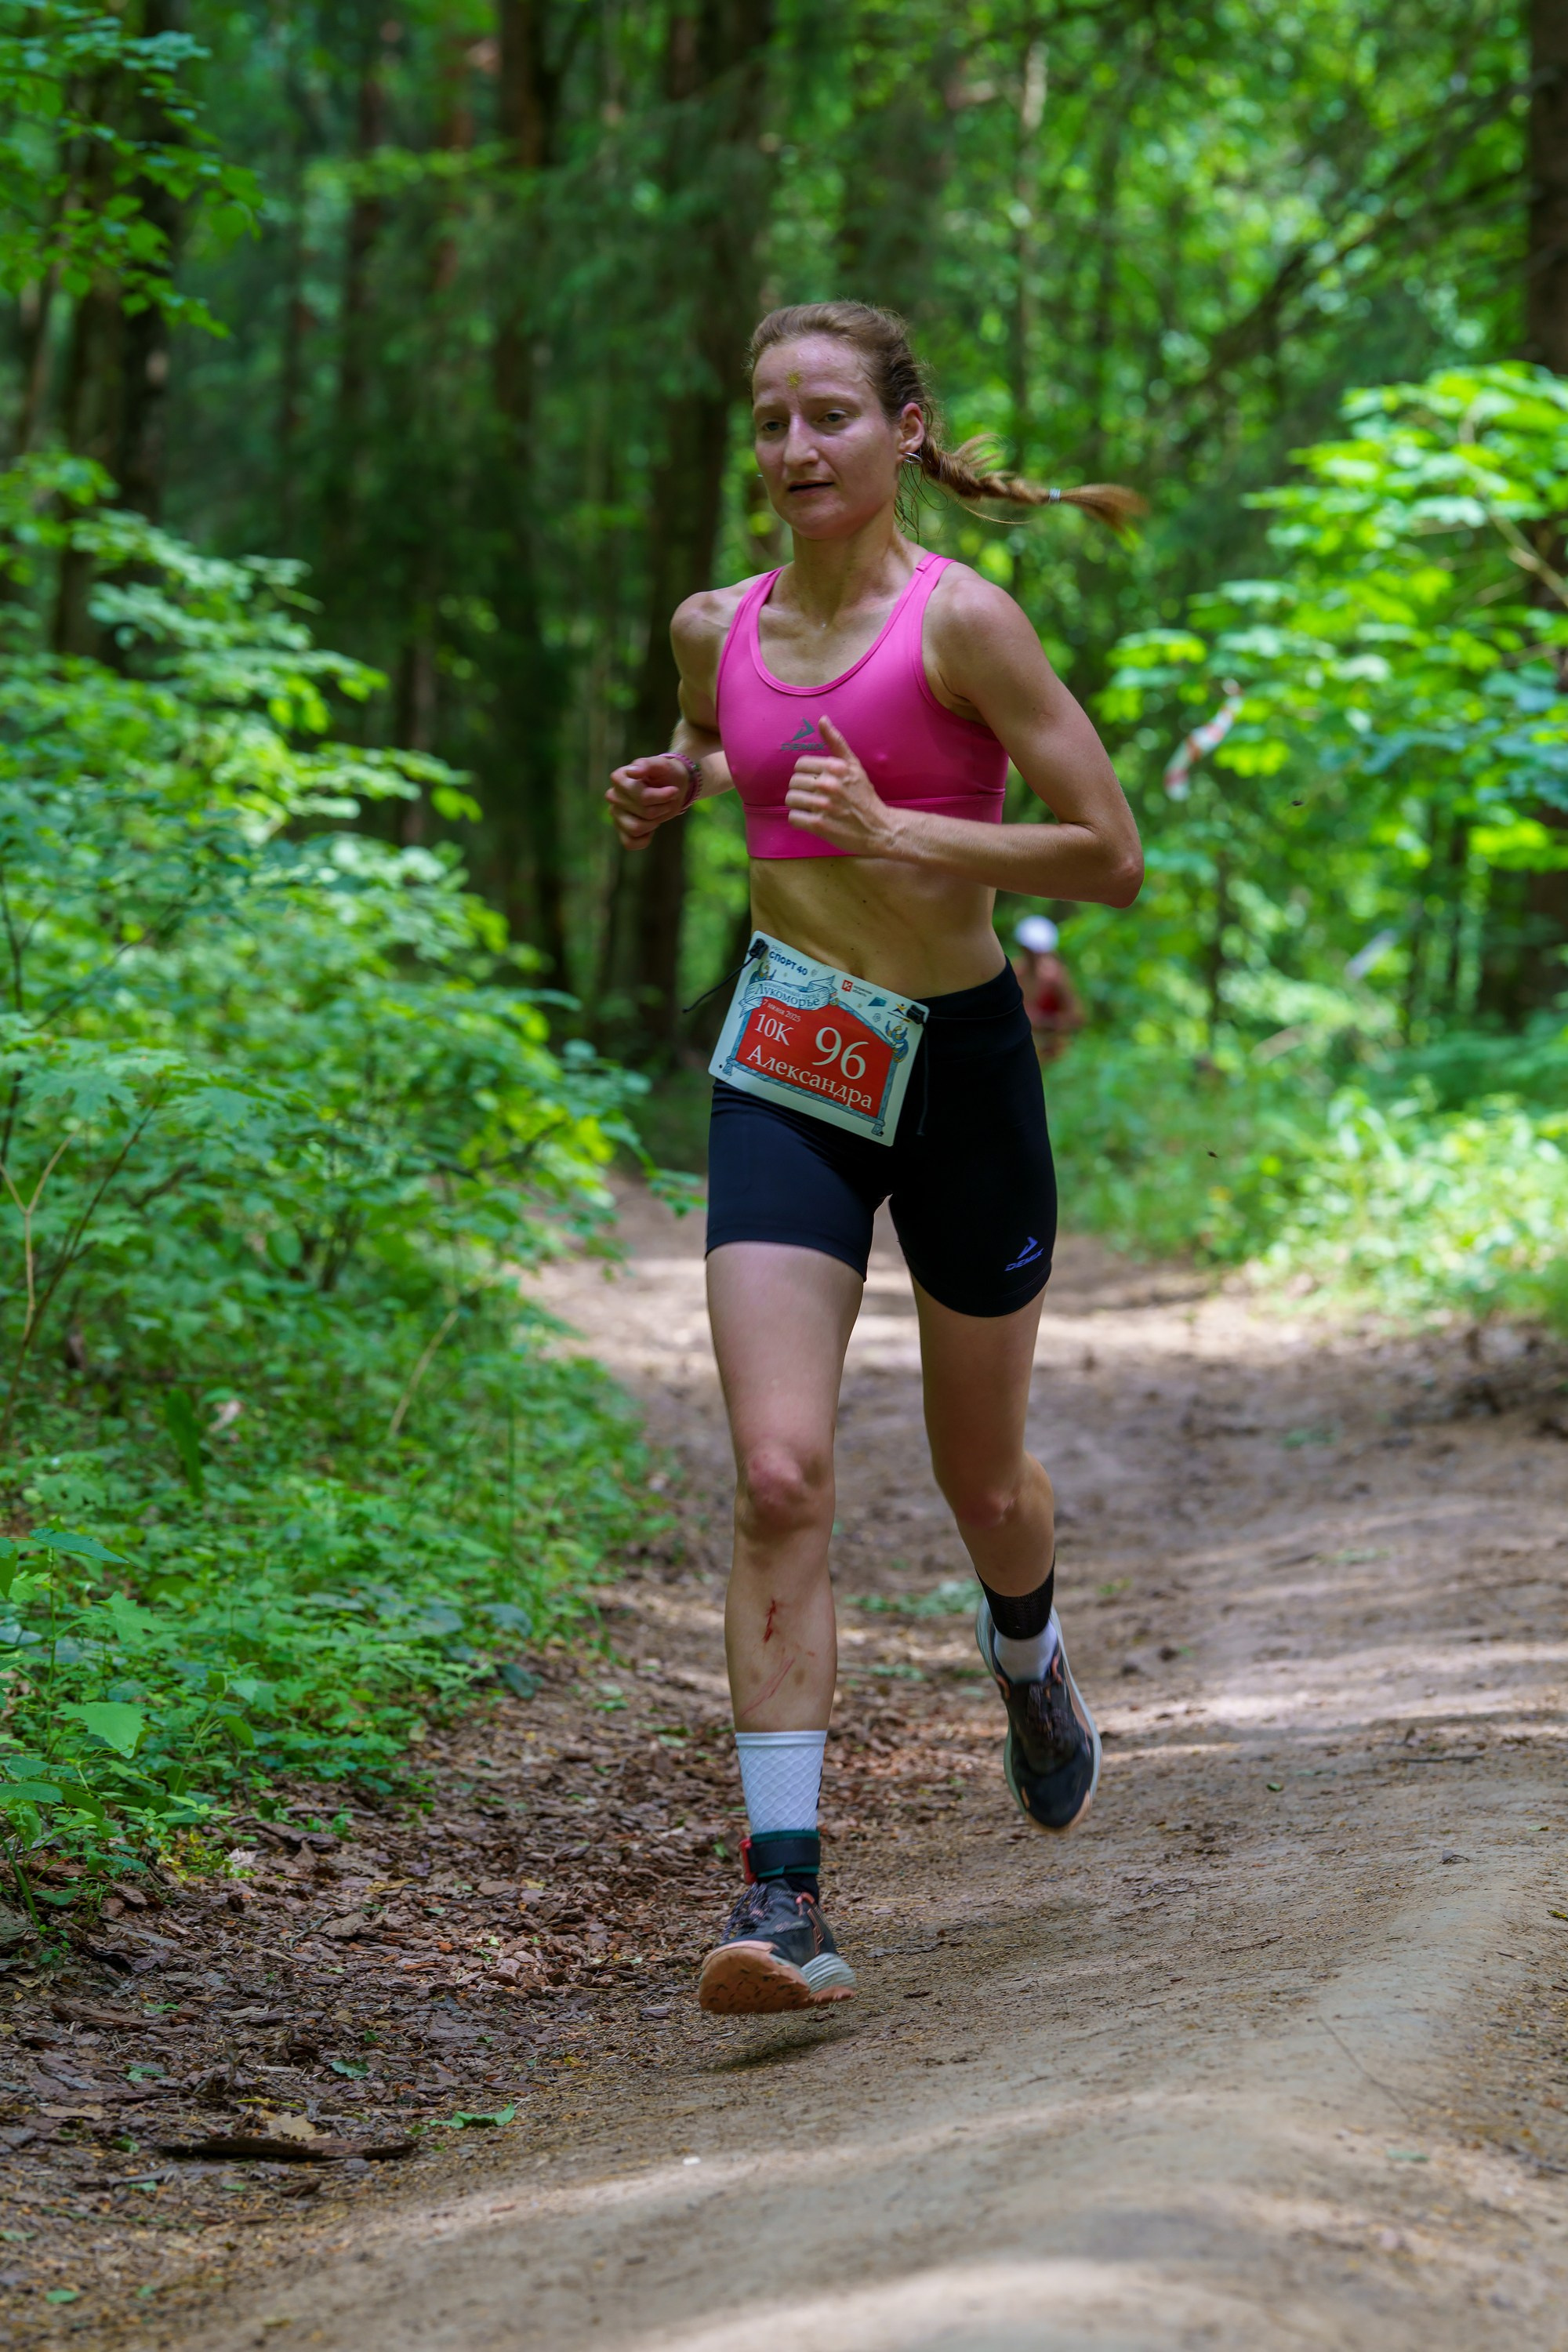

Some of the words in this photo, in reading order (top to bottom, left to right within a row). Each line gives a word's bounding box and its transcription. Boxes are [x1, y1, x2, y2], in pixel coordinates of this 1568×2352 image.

[768, 951, 797, 970] СПОРТ
[797, 966, 808, 975] 40
[754, 983, 819, 1007] Лукоморье
[785, 1011, 802, 1022] 2025
[812, 1027, 869, 1080] 96
[746, 1045, 872, 1109] Александра
